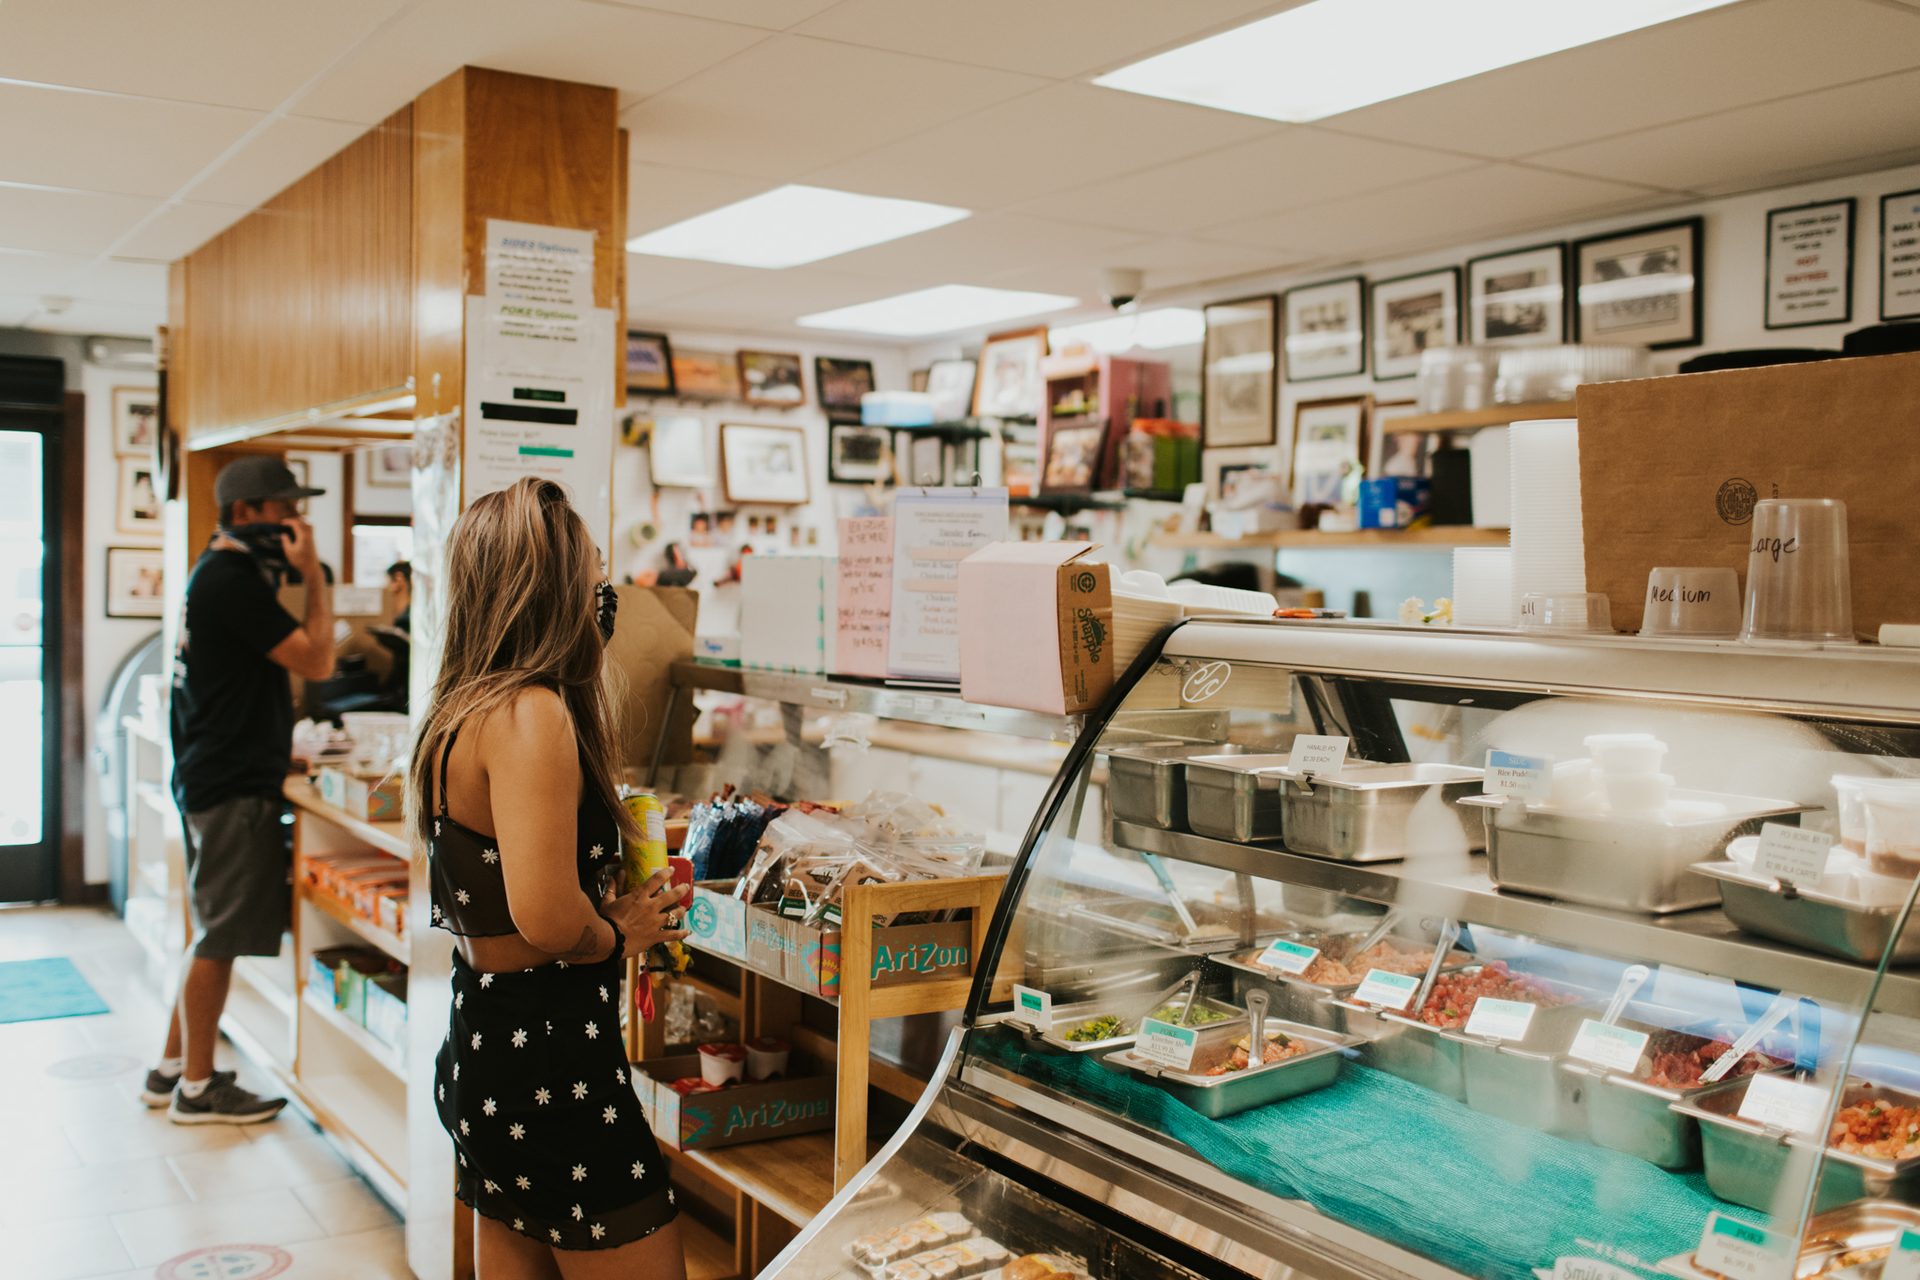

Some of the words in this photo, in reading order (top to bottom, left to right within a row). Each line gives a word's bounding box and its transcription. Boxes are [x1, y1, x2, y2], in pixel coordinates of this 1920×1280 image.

[500, 304, 532, 316] POKE
[536, 308, 578, 321] Options
[1650, 584, 1711, 605] Medium
[1078, 608, 1101, 664] Snapple
[1498, 769, 1511, 777] Rice
[870, 942, 968, 981] AriZon
[723, 1097, 829, 1138] AriZona
[1736, 1228, 1764, 1245] POKE
